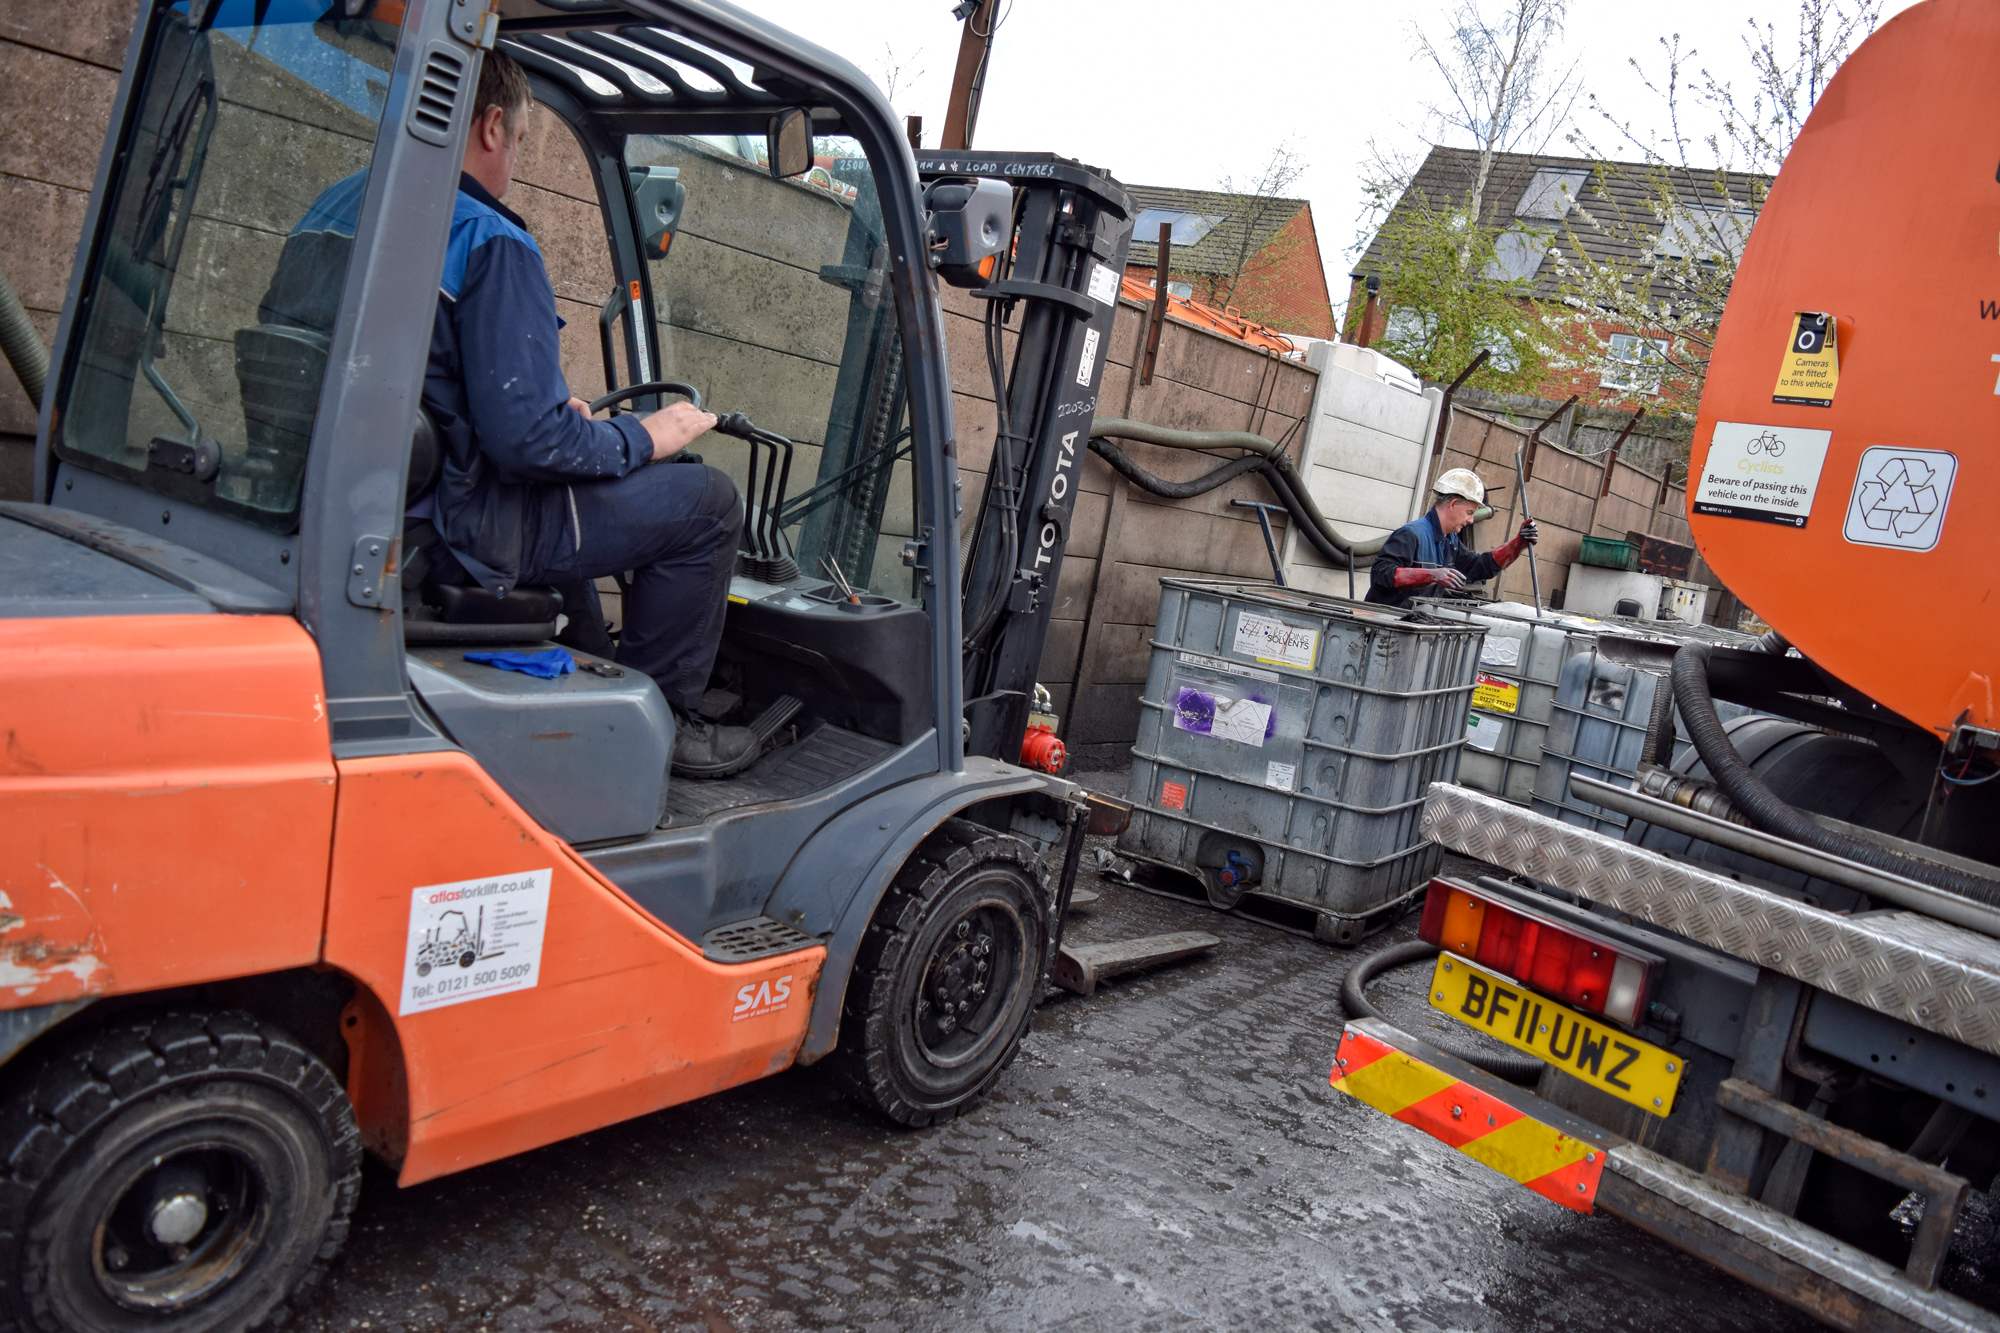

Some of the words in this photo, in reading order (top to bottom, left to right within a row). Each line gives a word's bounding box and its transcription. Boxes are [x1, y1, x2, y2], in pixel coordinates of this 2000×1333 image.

[839, 159, 864, 171] 2500
[966, 162, 997, 173] LOAD
[1004, 164, 1054, 177] CENTRES
[1795, 358, 1829, 368] Cameras
[1780, 378, 1789, 386] to
[1790, 379, 1804, 387] this
[1805, 380, 1833, 389] vehicle
[1806, 369, 1827, 378] fitted
[1057, 396, 1096, 418] 220303
[1737, 458, 1784, 475] Cyclists
[1707, 474, 1740, 487] Beware
[1742, 478, 1753, 488] of
[1753, 481, 1788, 495] passing
[1789, 484, 1807, 495] this
[1034, 430, 1079, 569] TOOTA
[1708, 488, 1738, 500] vehicle
[1739, 494, 1751, 502] on
[1753, 493, 1769, 504] the
[1771, 496, 1799, 508] inside
[1266, 634, 1309, 650] SOLVENTS
[429, 877, 535, 904] atlasforklift.co.uk
[411, 984, 434, 1000] Tel:
[437, 975, 469, 993] 0121
[473, 970, 497, 986] 500
[500, 963, 531, 981] 5009
[733, 974, 793, 1014] SAS
[1460, 973, 1542, 1046] BF11
[1548, 1013, 1641, 1093] UWZ
